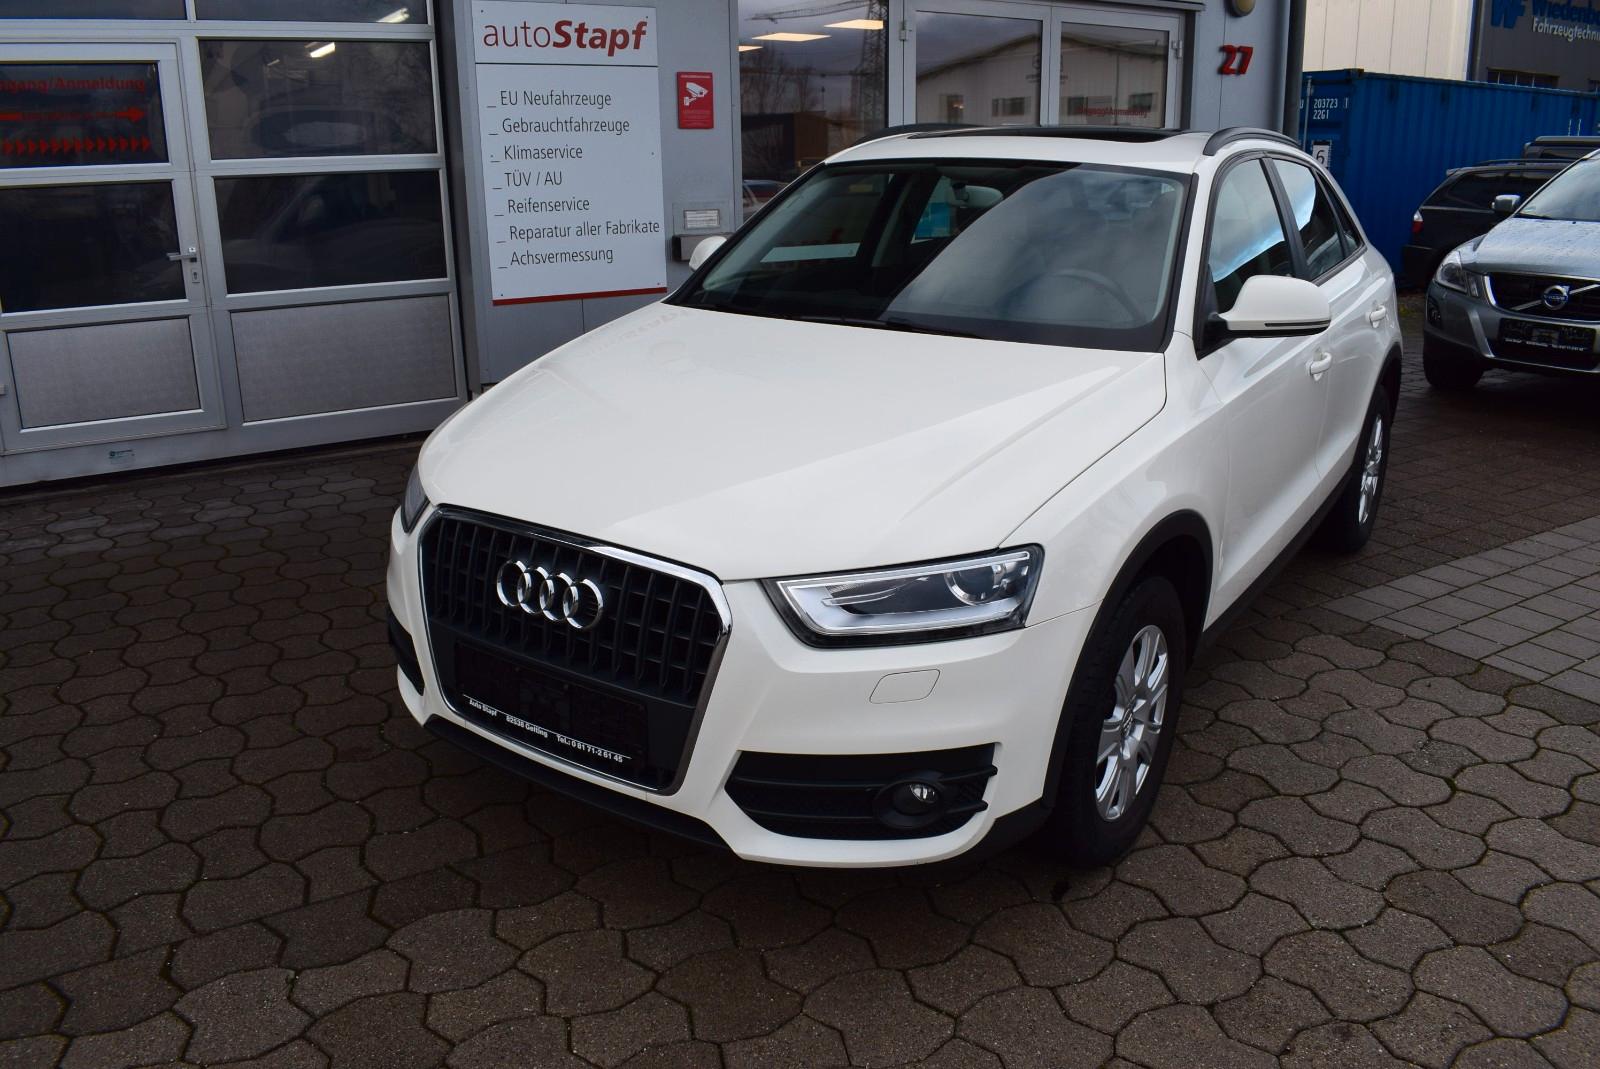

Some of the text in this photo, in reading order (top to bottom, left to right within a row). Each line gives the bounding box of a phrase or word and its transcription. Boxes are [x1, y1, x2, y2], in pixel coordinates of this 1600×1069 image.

[483, 20, 648, 57] autoStapf
[1217, 44, 1254, 75] 27
[500, 90, 612, 110] EU Neufahrzeuge
[1313, 98, 1338, 109] 203723
[1312, 109, 1330, 120] 22G1
[502, 117, 630, 136] Gebrauchtfahrzeuge
[504, 144, 583, 160] Klimaservice
[504, 170, 532, 187] TÜV
[544, 171, 563, 186] AU
[508, 197, 590, 214] Reifenservice
[509, 219, 660, 243] Reparatur aller Fabrikate
[510, 249, 614, 266] Achsvermessung
[469, 698, 482, 710] Auto
